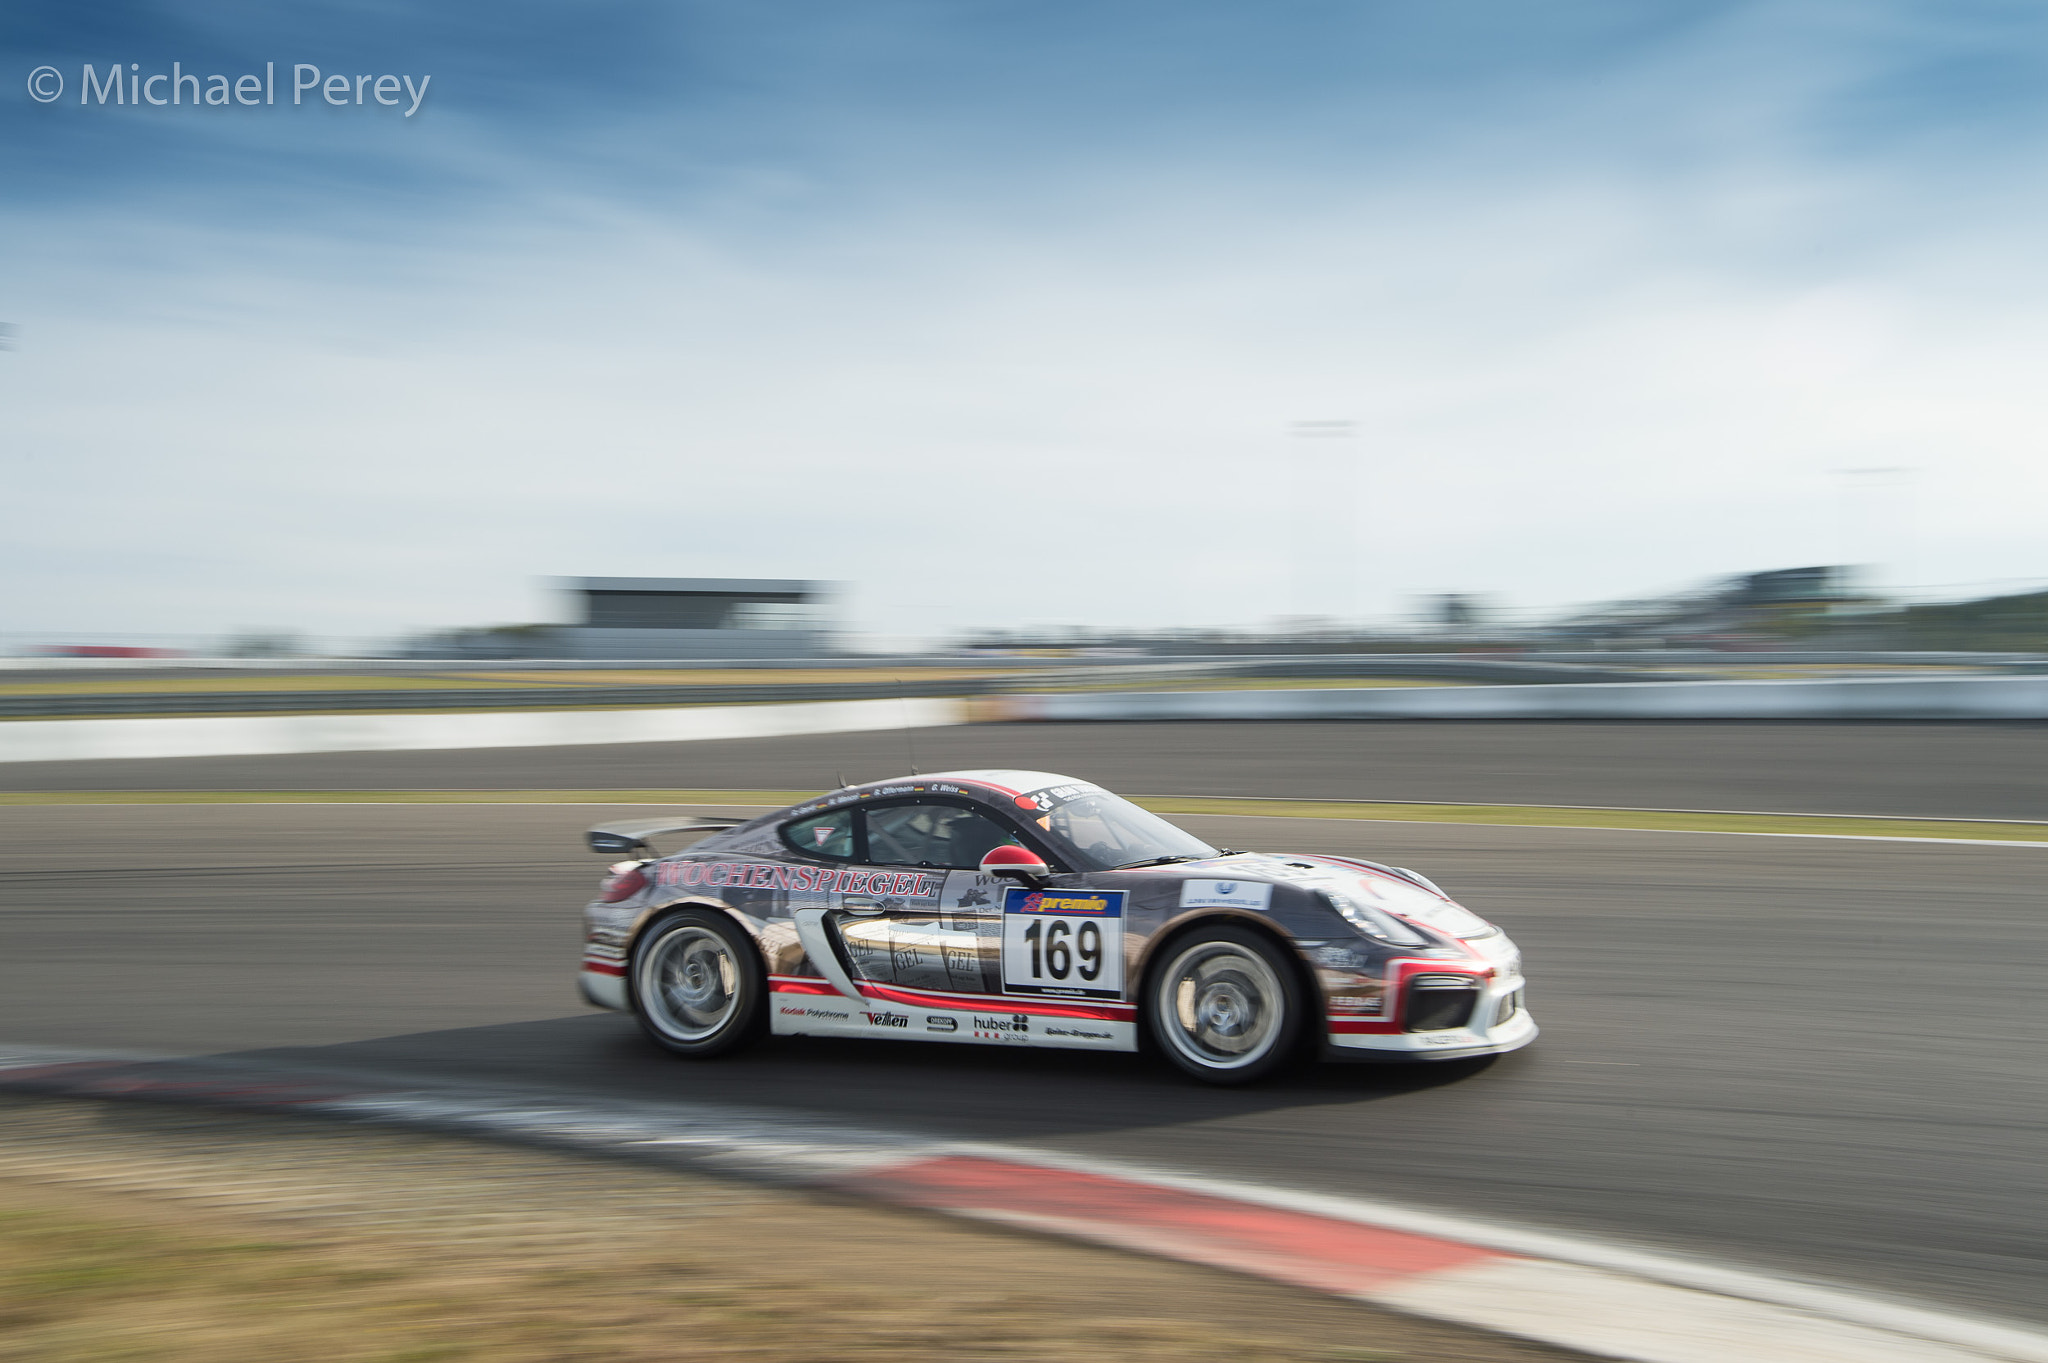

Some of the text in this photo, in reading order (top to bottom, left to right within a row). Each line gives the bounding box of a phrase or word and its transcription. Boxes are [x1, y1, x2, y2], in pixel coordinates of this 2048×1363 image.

[940, 784, 959, 793] Weiss
[656, 861, 932, 898] WOCHENSPIEGEL
[1037, 895, 1108, 912] premio
[1024, 918, 1102, 981] 169
[894, 948, 924, 971] GEL
[973, 1015, 1012, 1031] huber
[1003, 1032, 1029, 1043] group
